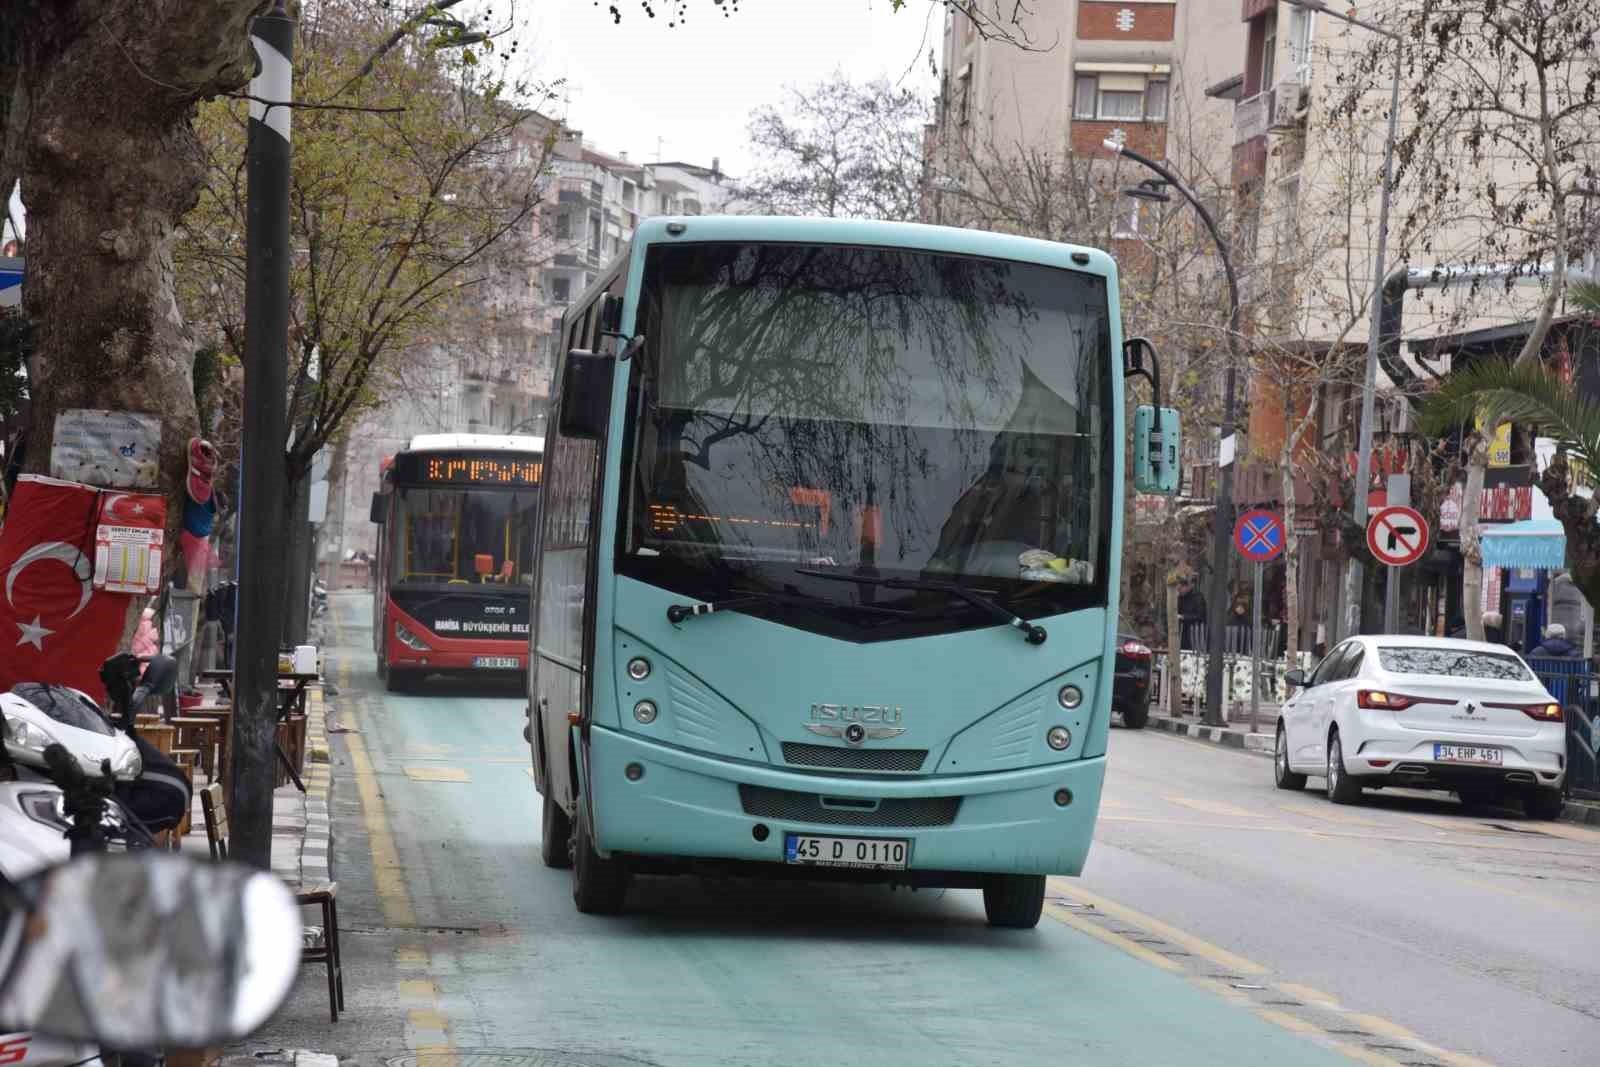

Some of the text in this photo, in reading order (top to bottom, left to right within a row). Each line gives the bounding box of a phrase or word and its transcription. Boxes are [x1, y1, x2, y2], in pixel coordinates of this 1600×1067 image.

[462, 622, 510, 634] BÜYÜKŞEHİR
[810, 702, 902, 724] ISUZU
[1441, 746, 1454, 758] 34
[1480, 749, 1499, 761] 461
[797, 838, 904, 862] 45 D 0110
